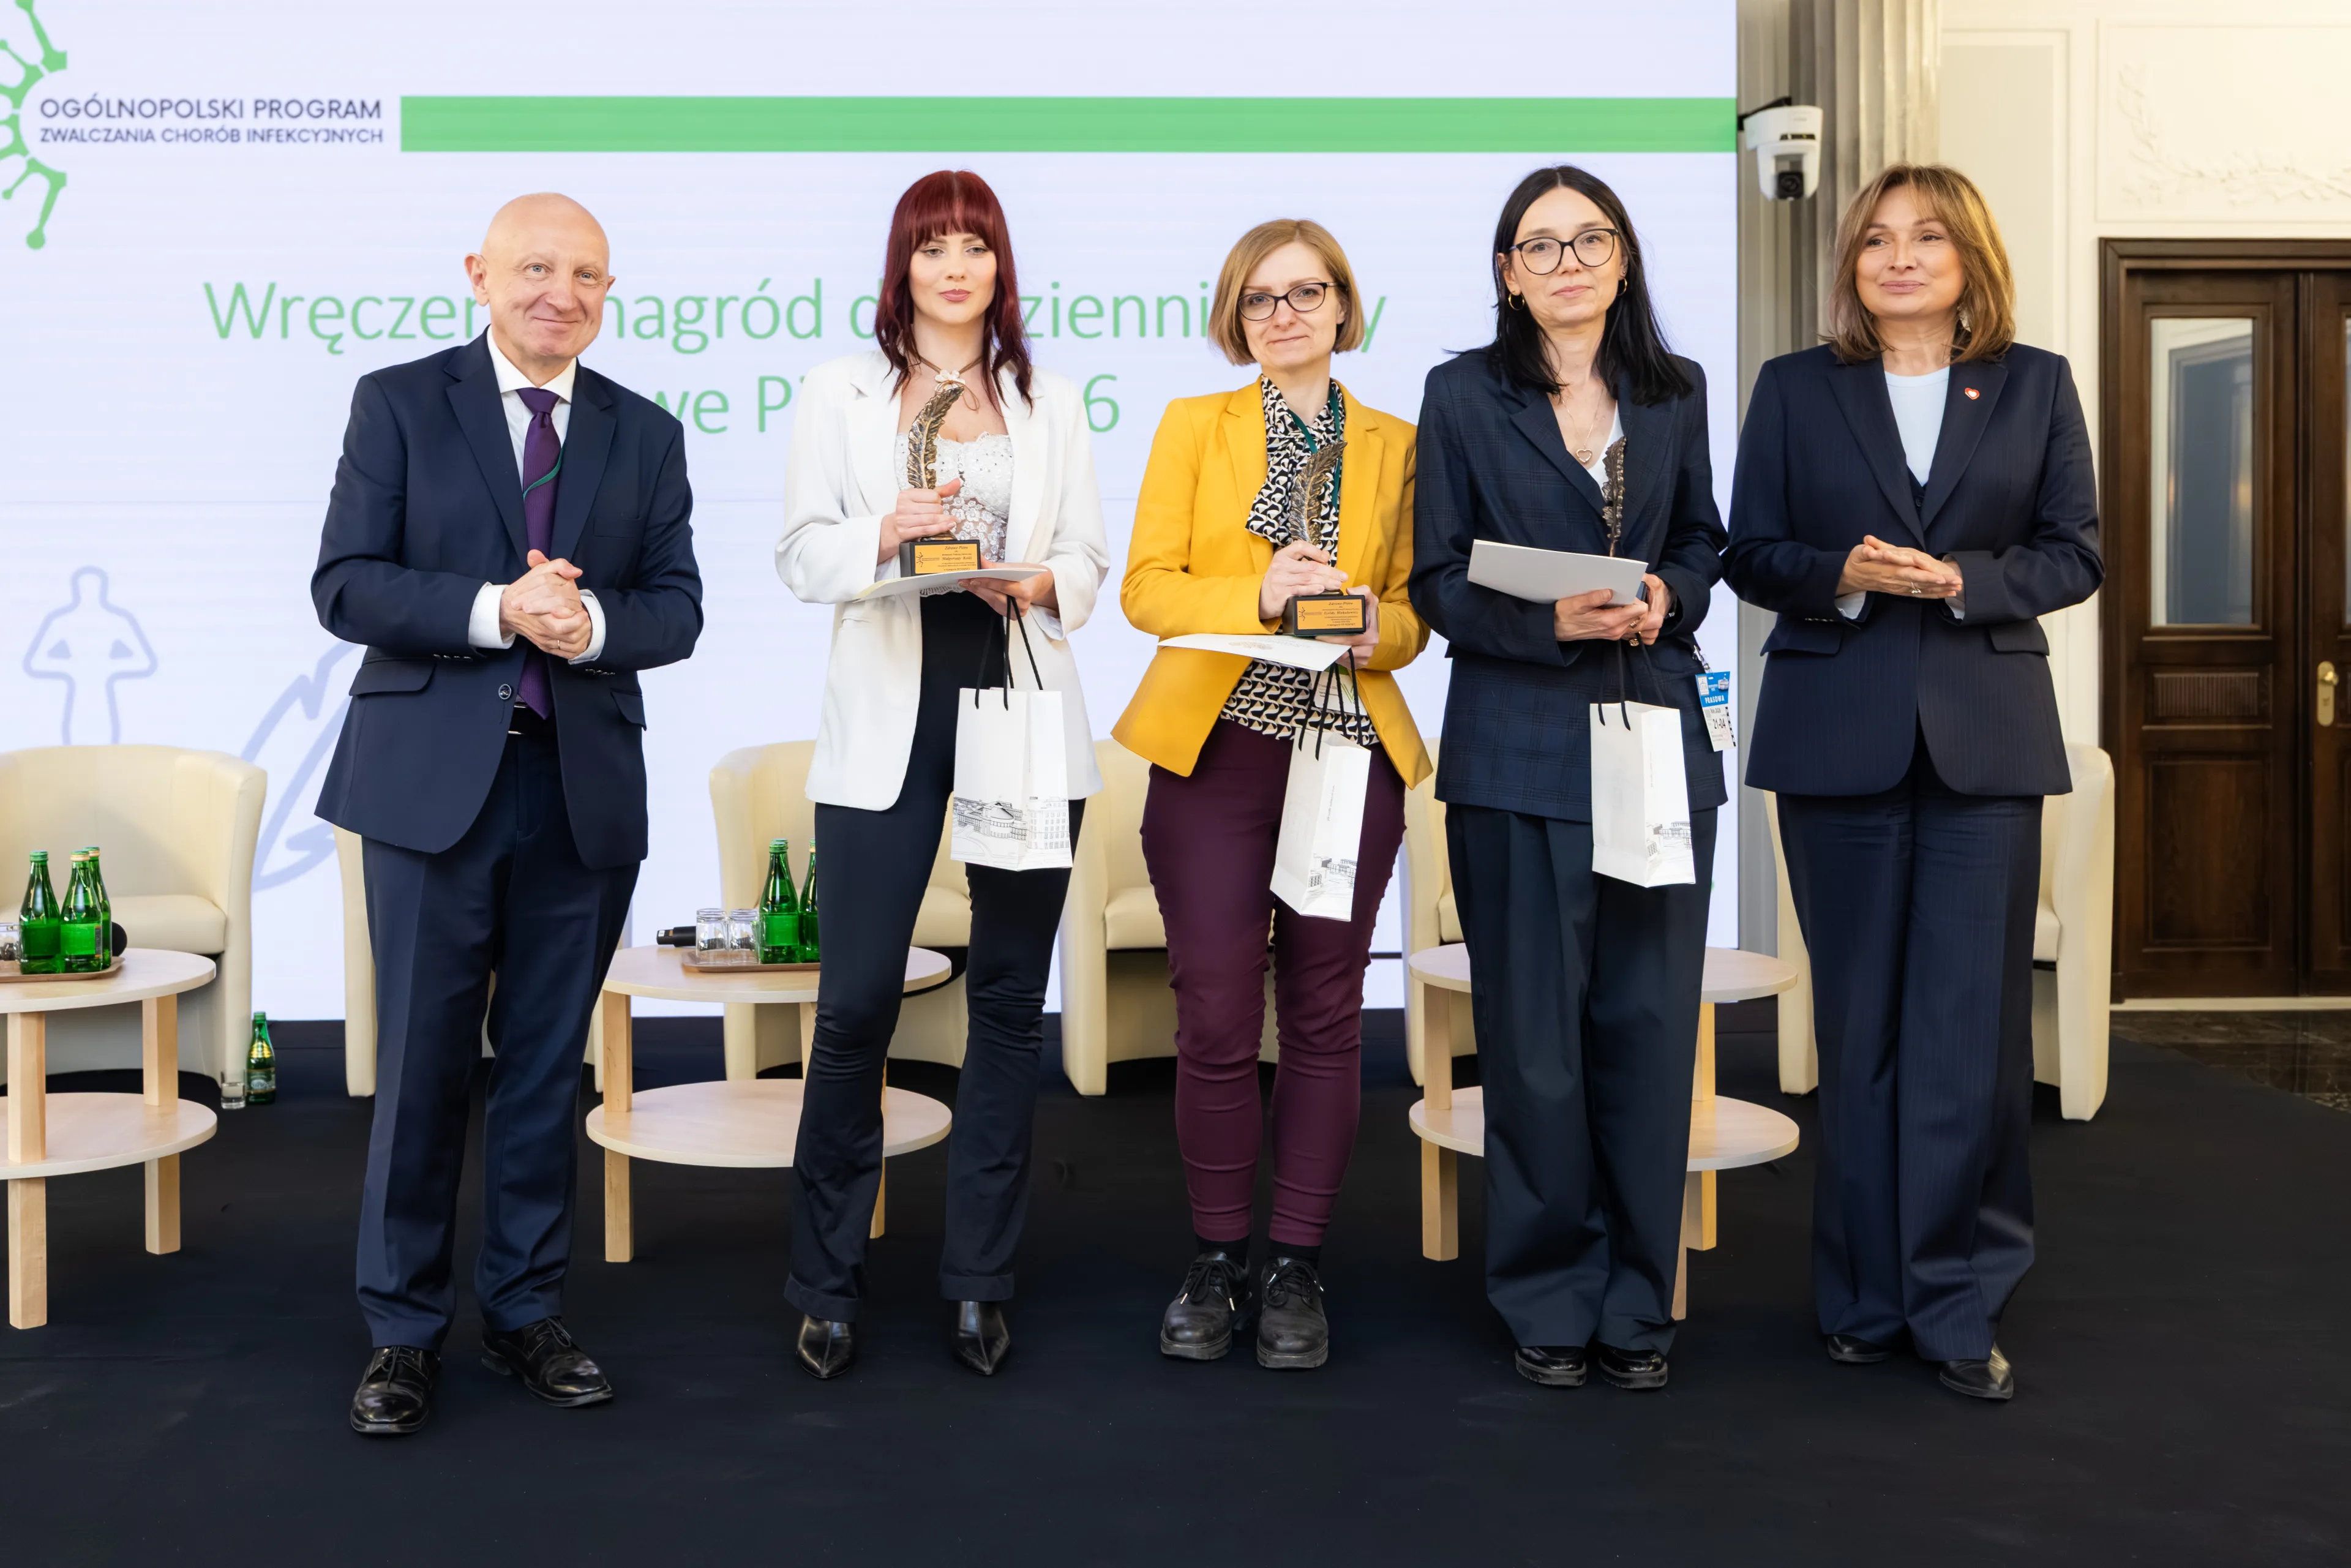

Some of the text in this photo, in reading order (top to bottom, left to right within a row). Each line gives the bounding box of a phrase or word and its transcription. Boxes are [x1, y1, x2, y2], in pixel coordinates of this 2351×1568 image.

[40, 94, 381, 119] OGÓLNOPOLSKI PROGRAM
[40, 125, 383, 143] ZWALCZANIA CHORÓB INFEKCYJNYCH
[203, 283, 476, 354] Wręcze
[602, 278, 821, 354] nagród
[1704, 695, 1725, 704] PRASOWA
